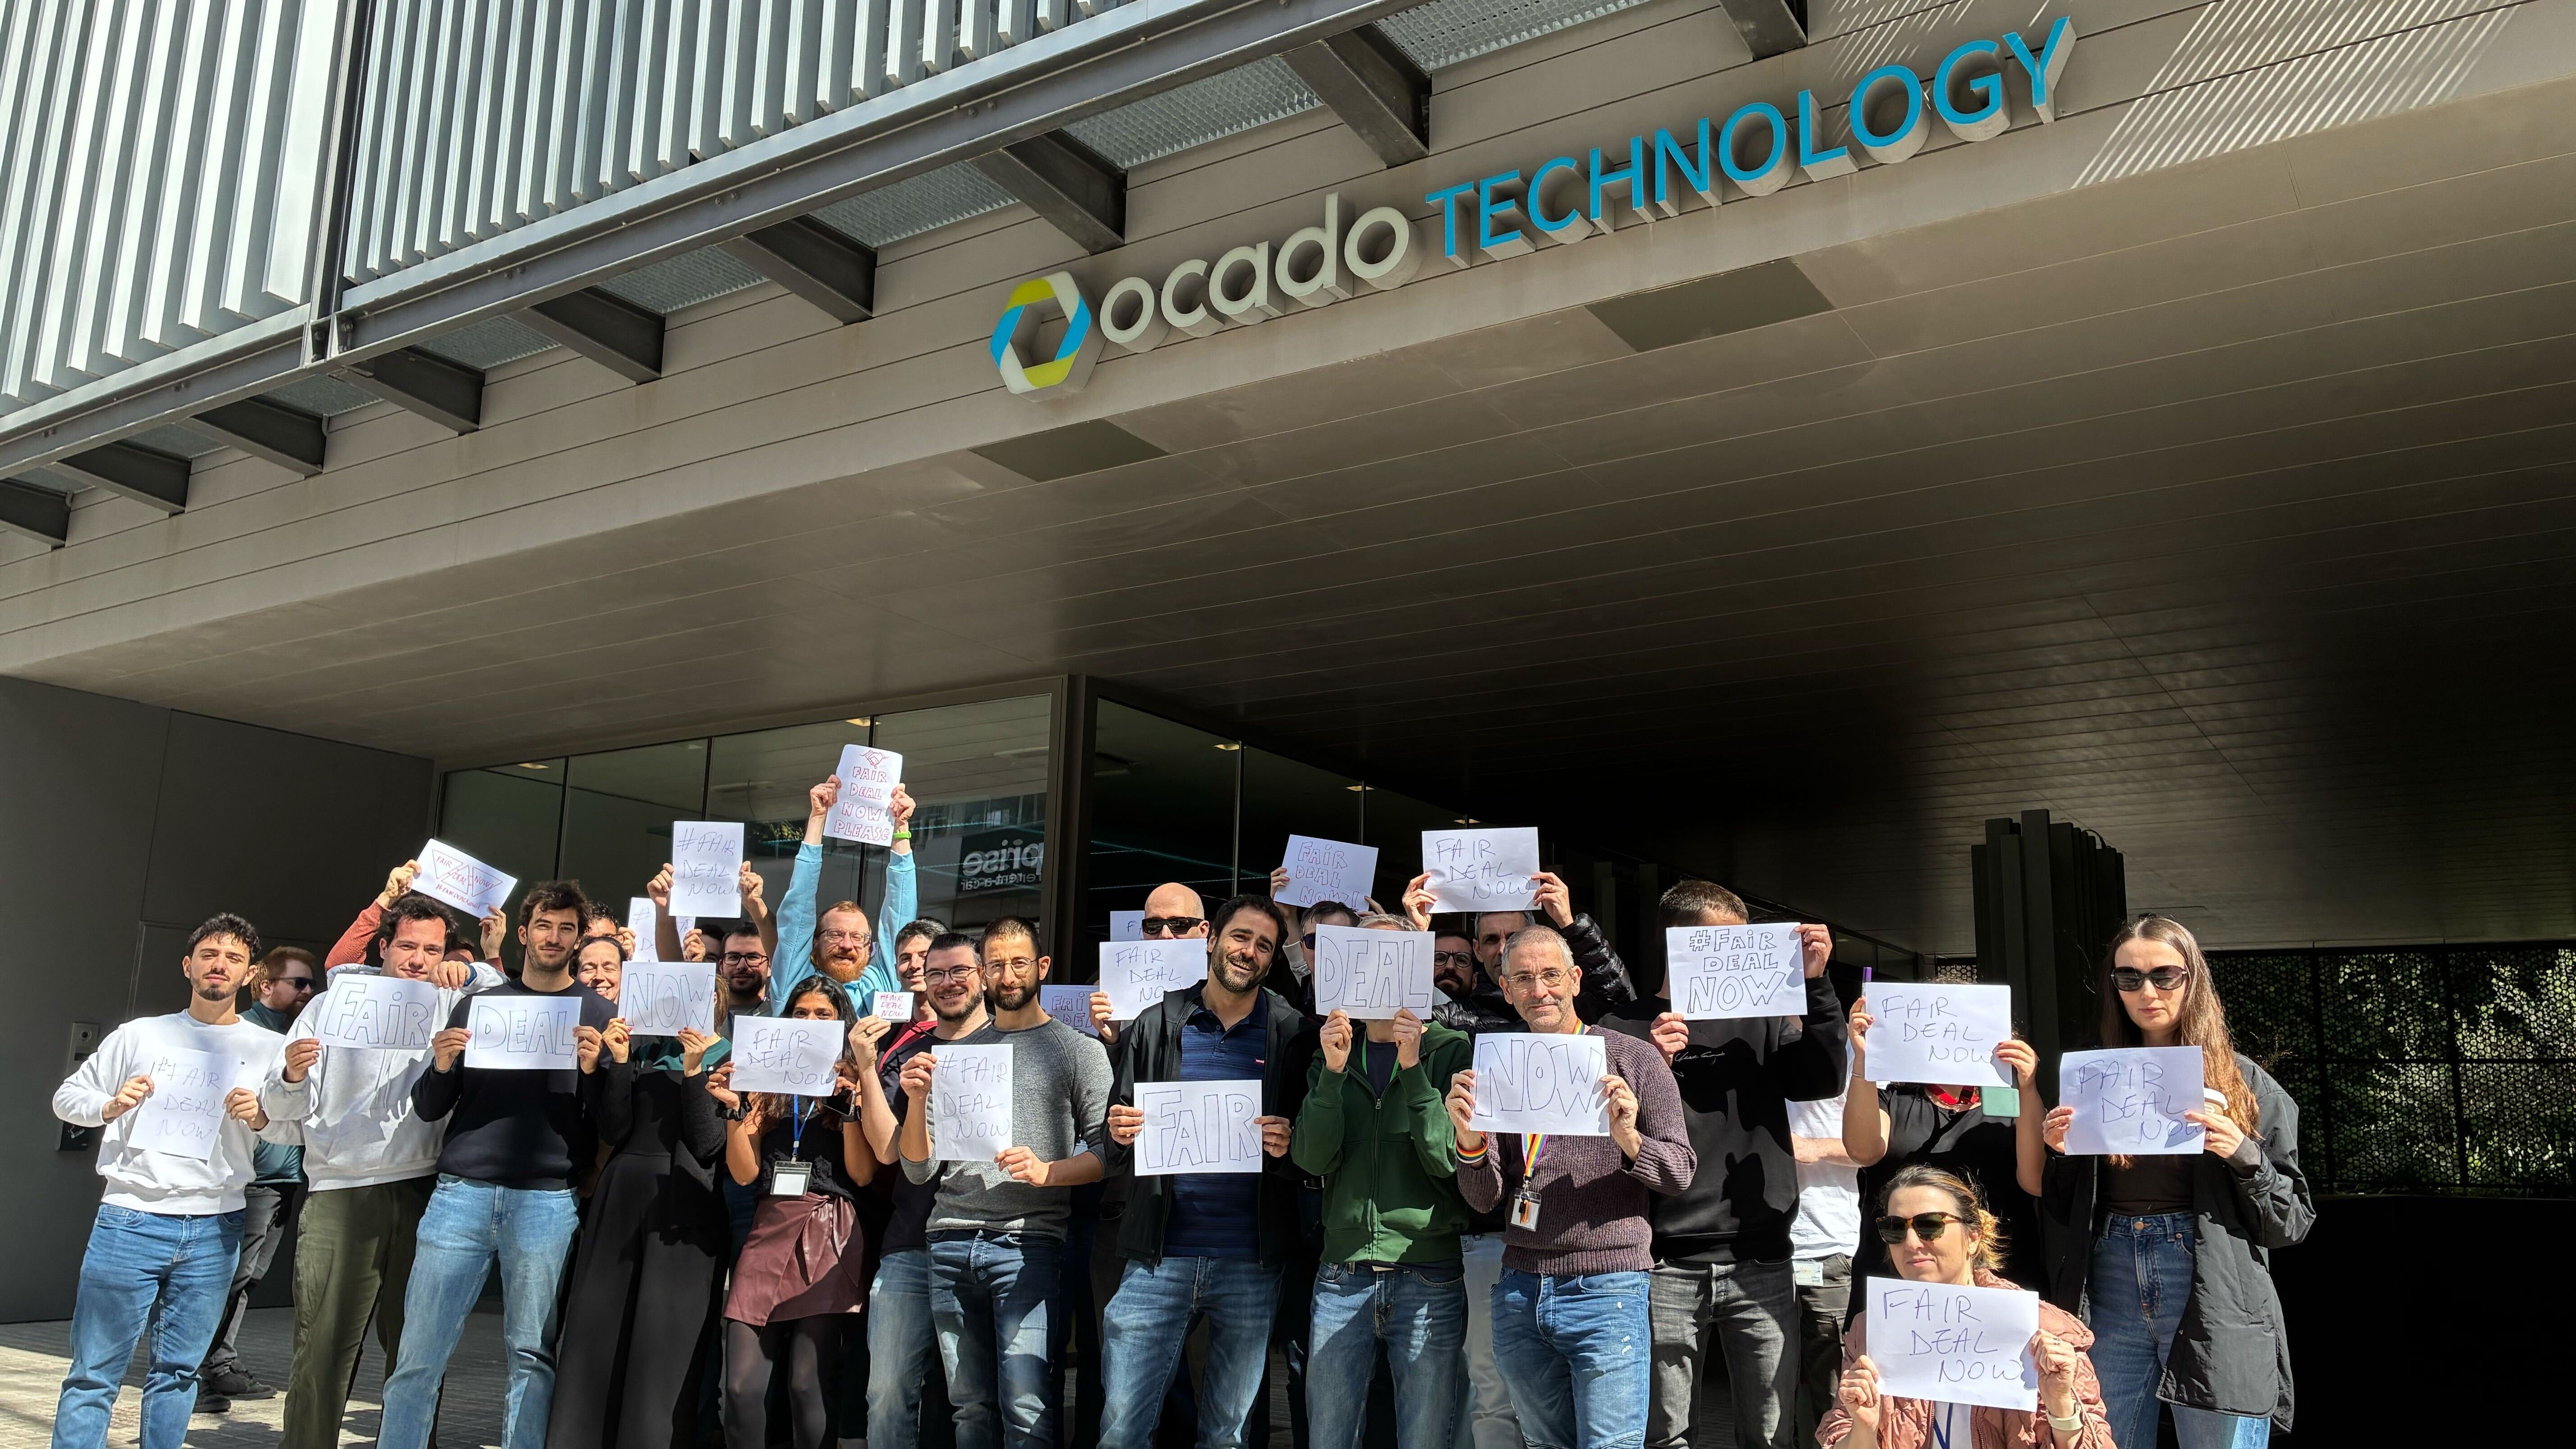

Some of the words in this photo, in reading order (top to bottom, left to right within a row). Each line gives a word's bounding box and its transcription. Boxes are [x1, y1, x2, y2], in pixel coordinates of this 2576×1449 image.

[1100, 192, 1410, 344] ocado
[1426, 16, 2070, 257] TECHNOLOGY
[853, 767, 887, 783] FAIR
[849, 782, 882, 800] DEAL
[842, 802, 882, 821] NOW
[677, 828, 735, 856] #FAIR
[1436, 838, 1496, 863] FAIR
[437, 856, 452, 868] FAIR
[681, 860, 730, 879] DEAL
[1447, 861, 1513, 883] DEAL
[451, 872, 467, 885] DEAL
[1296, 865, 1341, 888] DEAL
[1472, 876, 1531, 900] NOW
[688, 883, 734, 896] NOW
[1116, 946, 1163, 967] FAIR
[1703, 953, 1778, 972] DEAL
[1129, 968, 1182, 984] DEAL
[1320, 935, 1429, 1009] DEAL
[625, 973, 715, 1029] NOW
[1687, 971, 1786, 1013] NOW
[1882, 995, 1958, 1018] FAIR
[474, 1005, 575, 1058] DEAL
[753, 1028, 812, 1050] FAIR
[1903, 1022, 1983, 1042] DEAL
[748, 1051, 810, 1068] DEAL
[1928, 1045, 1992, 1063] NOW
[783, 1070, 834, 1085] NOW
[938, 1052, 1010, 1084] #FAIR
[1474, 1038, 1602, 1117] NOW
[2079, 1060, 2165, 1093] FAIR
[164, 1094, 219, 1118] DEAL
[943, 1092, 1003, 1117] DEAL
[2102, 1091, 2188, 1123] DEAL
[156, 1119, 212, 1140] NOW
[956, 1118, 1010, 1138] NOW
[1143, 1090, 1260, 1168] FAIR
[2136, 1119, 2206, 1144] NOW
[1883, 1288, 1981, 1323] FAIR
[1909, 1328, 1998, 1356] DEAL
[1939, 1359, 2022, 1382] NOW
